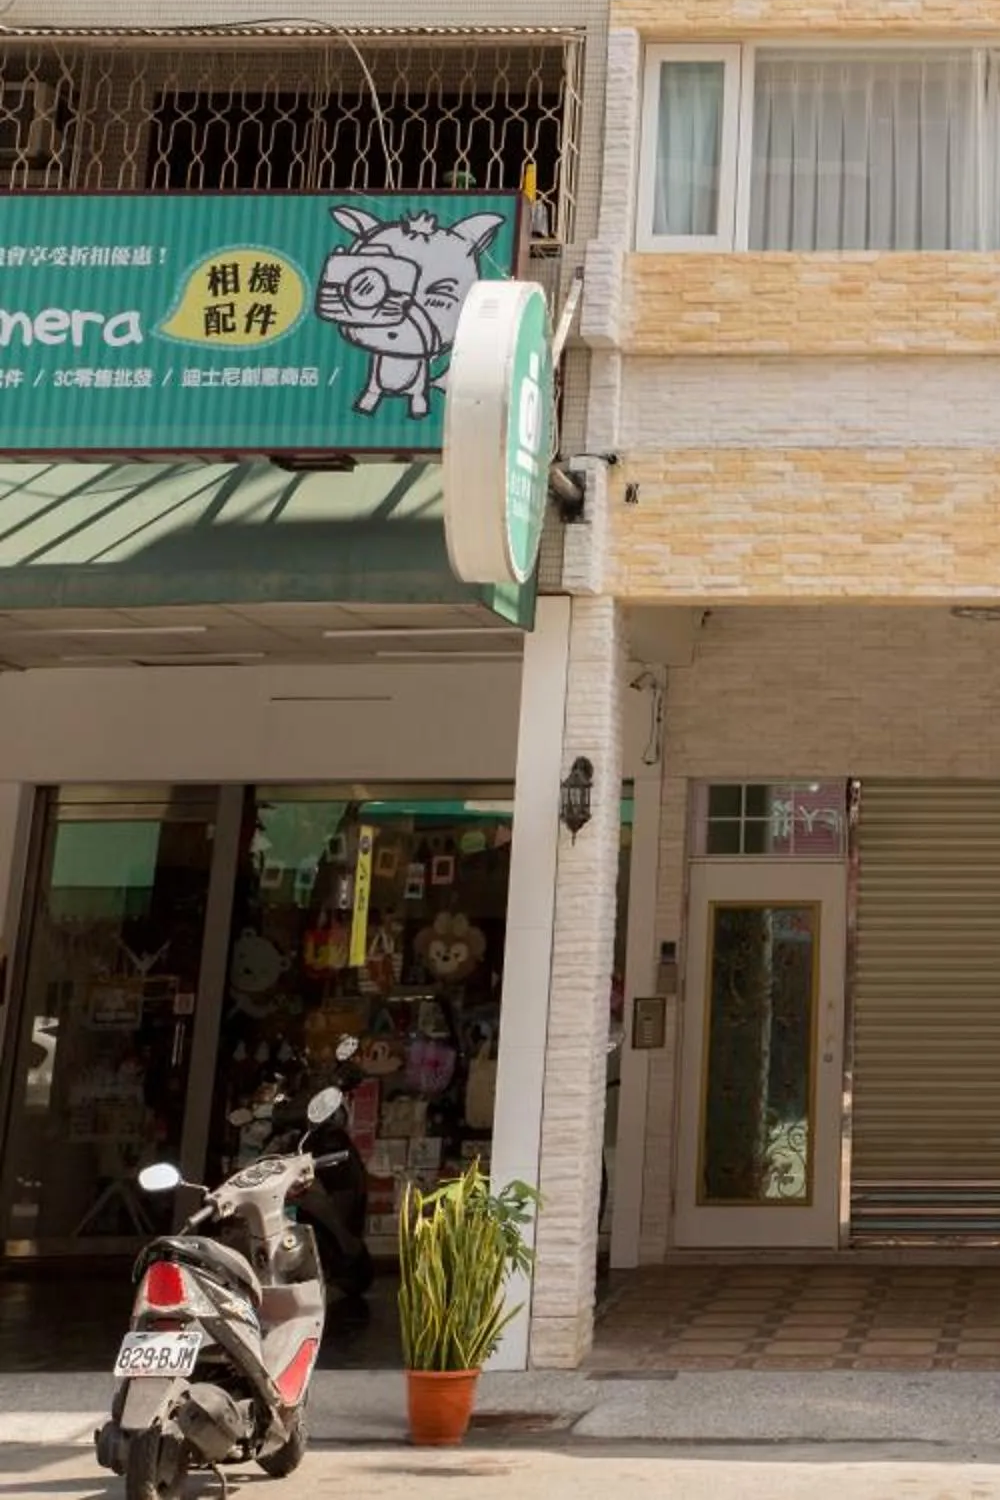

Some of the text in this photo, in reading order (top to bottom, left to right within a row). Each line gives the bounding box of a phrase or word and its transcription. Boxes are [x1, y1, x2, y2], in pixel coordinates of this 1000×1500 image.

[206, 261, 282, 297] 相機
[204, 301, 278, 337] 配件
[118, 1346, 196, 1369] 829-BJM
